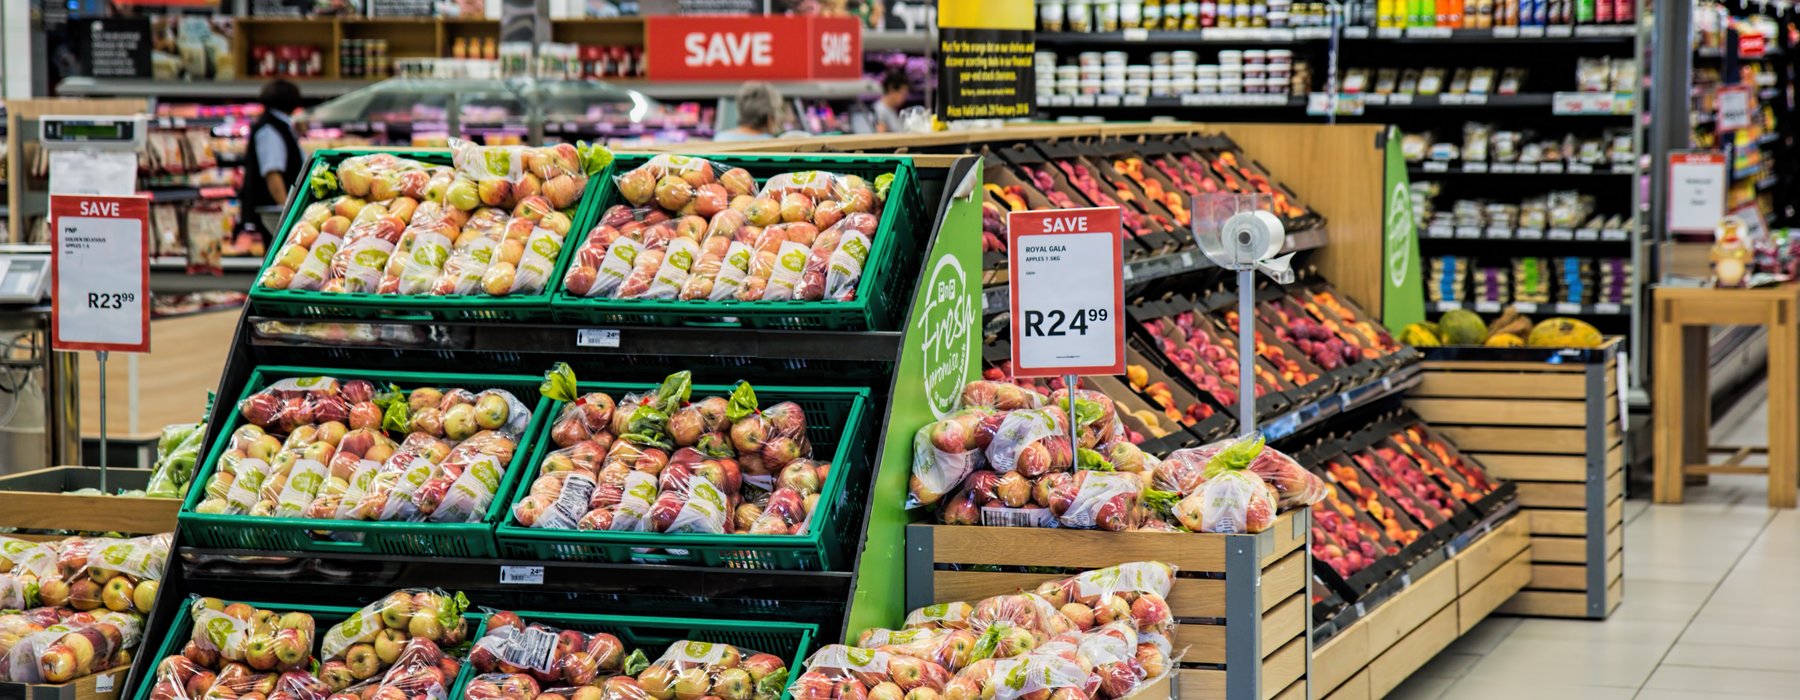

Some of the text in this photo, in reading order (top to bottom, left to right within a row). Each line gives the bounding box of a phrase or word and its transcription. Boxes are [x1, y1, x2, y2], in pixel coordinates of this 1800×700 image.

[684, 32, 773, 67] SAVE
[821, 31, 852, 67] SAVE
[80, 201, 120, 217] SAVE
[1042, 216, 1088, 233] SAVE
[917, 271, 976, 363] Fresh
